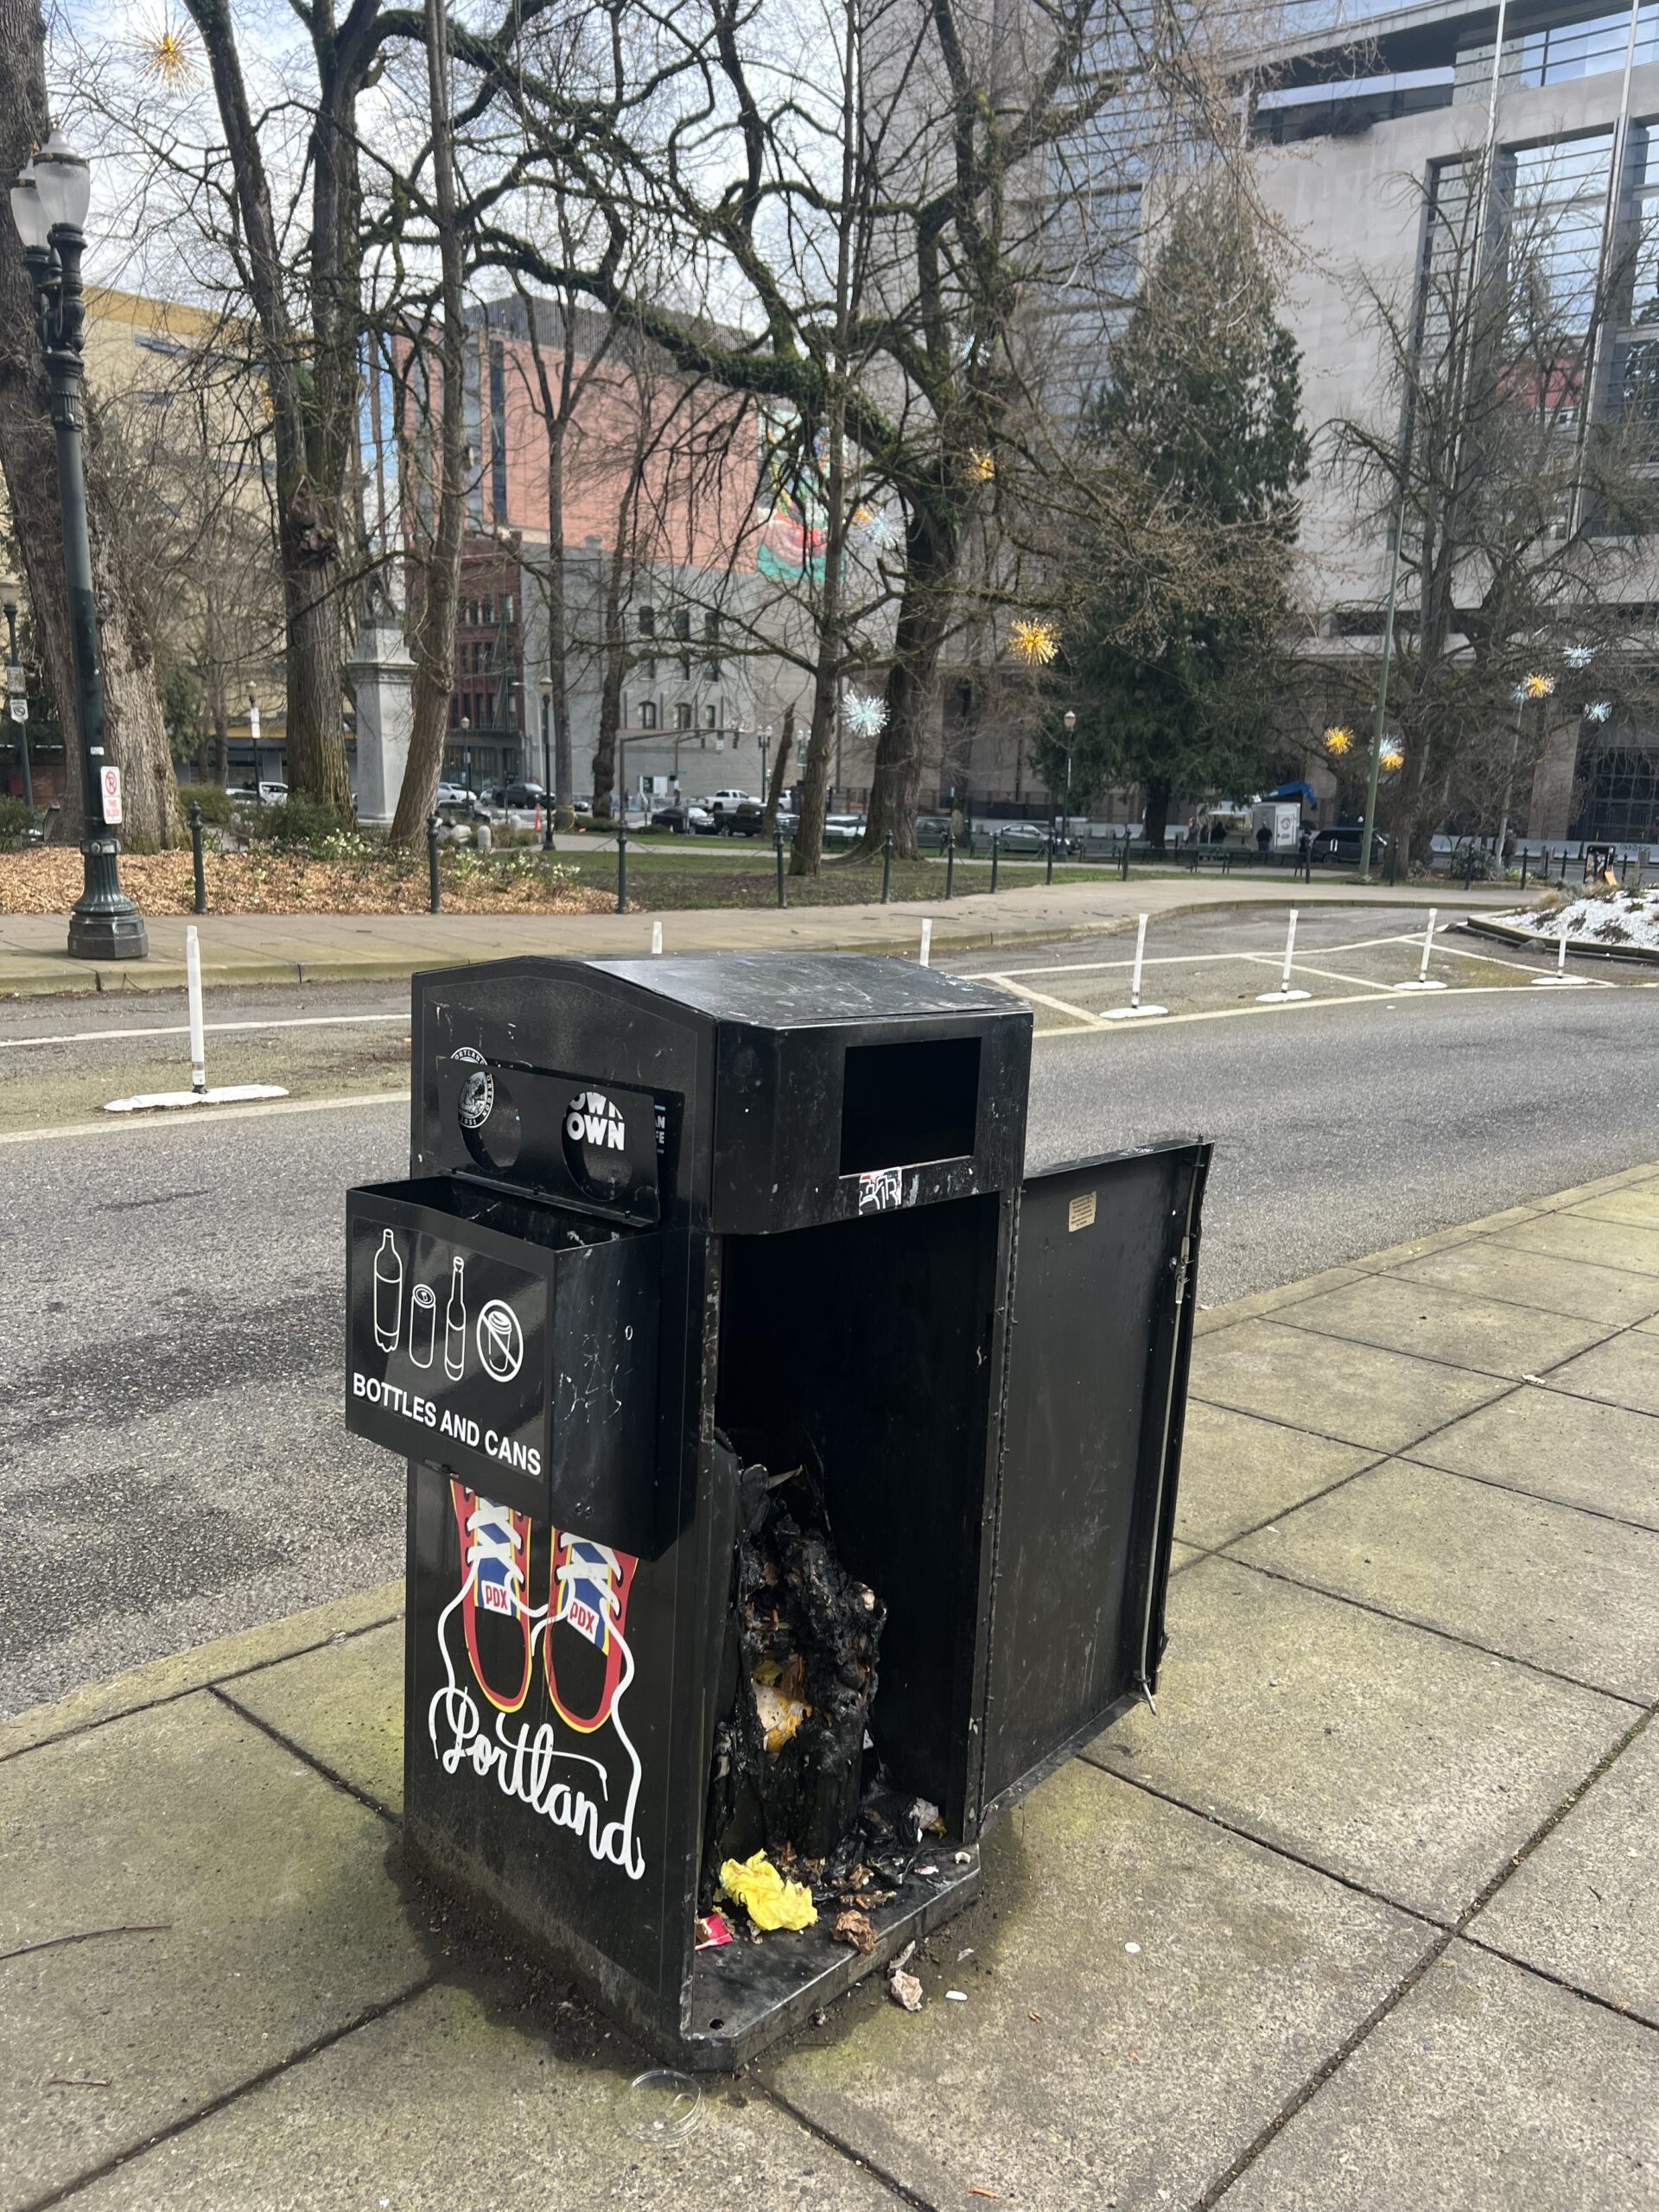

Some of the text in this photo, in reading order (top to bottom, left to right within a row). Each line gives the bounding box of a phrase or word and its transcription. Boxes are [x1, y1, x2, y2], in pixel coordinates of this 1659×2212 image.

[454, 1050, 485, 1065] ORTLAND
[482, 1075, 493, 1116] OREGON
[566, 1111, 626, 1151] OWN
[353, 1371, 541, 1476] BOTTLES AND CANS
[485, 1585, 508, 1611] PDX
[569, 1601, 596, 1635] PDX
[428, 1687, 645, 1880] Portland
